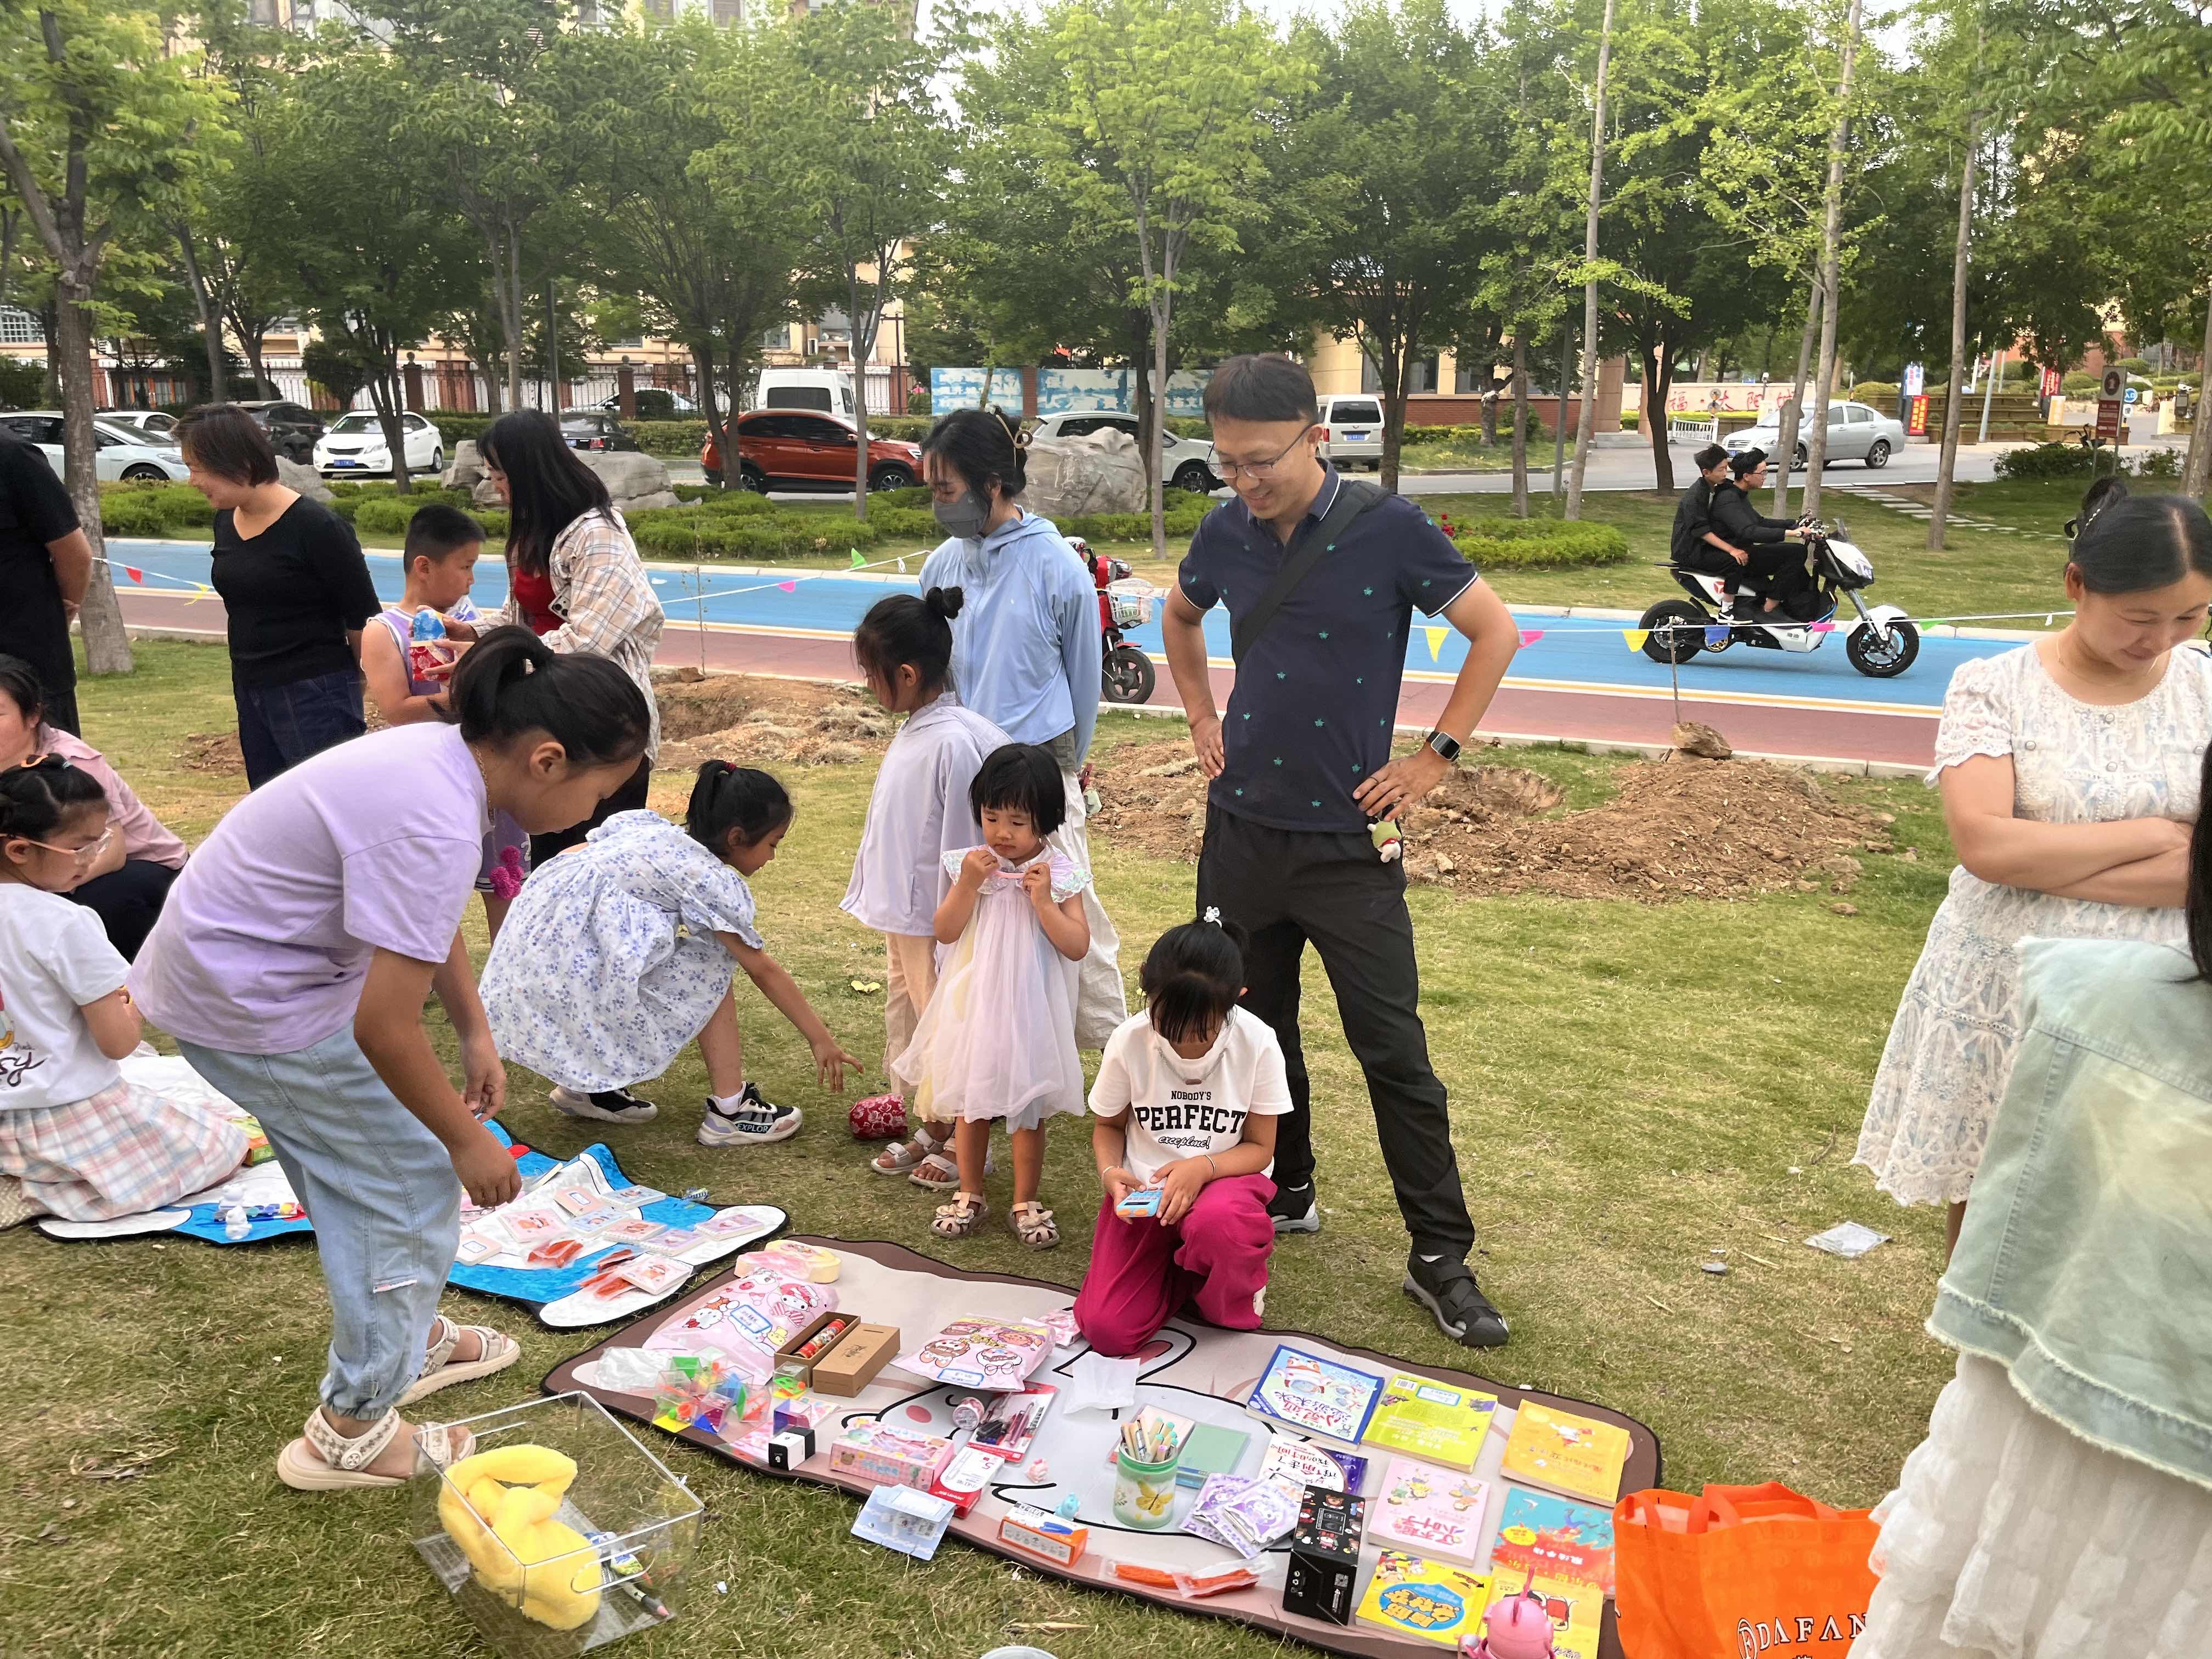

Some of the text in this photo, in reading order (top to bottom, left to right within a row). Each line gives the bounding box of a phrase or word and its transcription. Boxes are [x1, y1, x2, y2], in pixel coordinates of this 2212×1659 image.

[1171, 1091, 1211, 1100] NOBODY'S
[737, 1124, 769, 1132] EXPLOR
[1135, 1104, 1246, 1134] PERFECT
[1282, 1400, 1340, 1426] 小灵通
[1276, 1446, 1329, 1467] 我的时间
[1277, 1455, 1336, 1479] 谁偷走了
[1392, 1522, 1454, 1546] 了不起的
[1401, 1515, 1457, 1533] 小叶子
